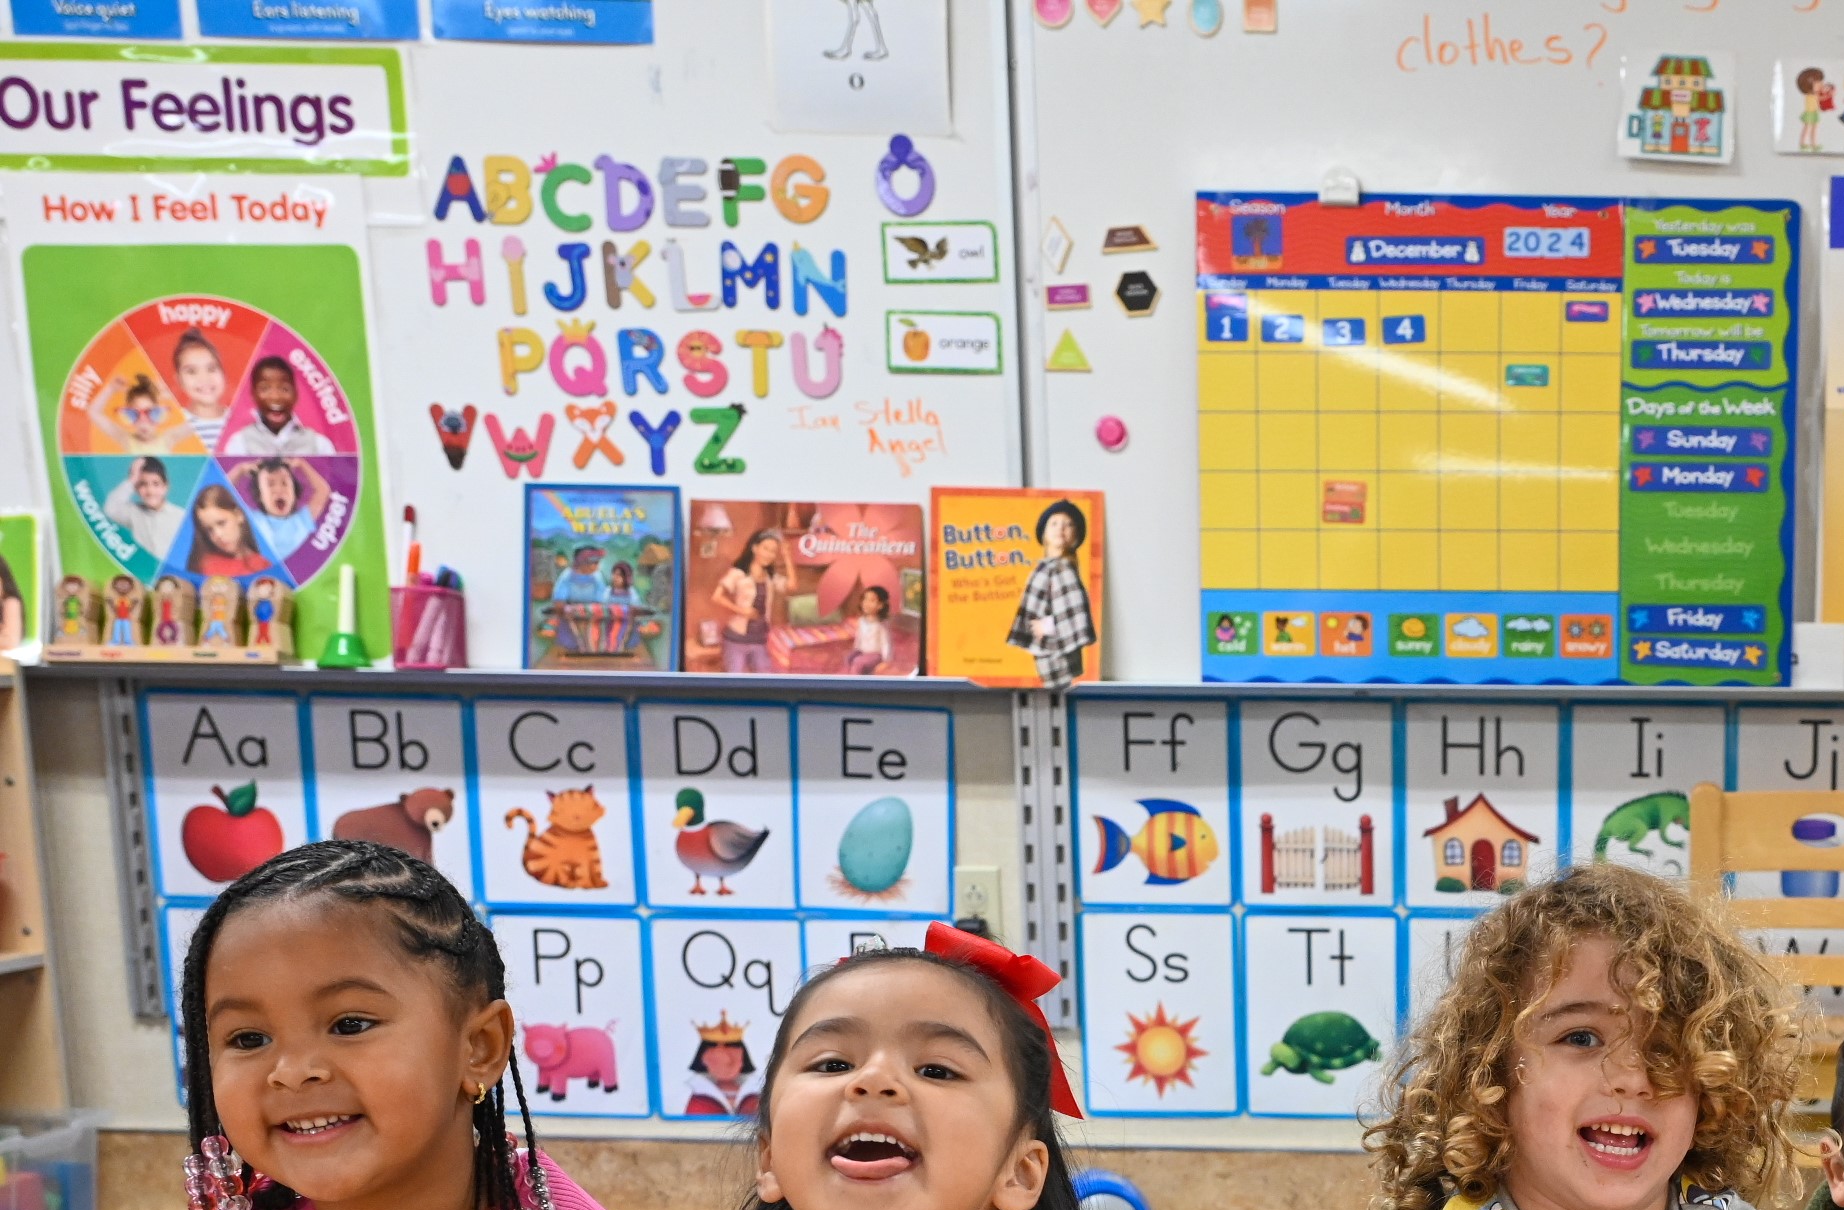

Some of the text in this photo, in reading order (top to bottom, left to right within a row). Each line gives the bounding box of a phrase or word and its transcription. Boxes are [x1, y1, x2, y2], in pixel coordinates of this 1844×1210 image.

[524, 6, 596, 28] watching
[0, 76, 356, 147] Our Feelings
[42, 194, 329, 228] How I Feel Today
[1229, 198, 1287, 215] Season
[1384, 200, 1436, 217] Month
[1542, 202, 1578, 219] Year
[1653, 218, 1757, 236] Yesterday was
[957, 245, 985, 261] owl
[1368, 239, 1463, 259] December
[1507, 230, 1585, 253] 2024
[1666, 237, 1741, 262] Tuesday
[1265, 276, 1309, 290] Monday
[1327, 276, 1371, 290] Tuesday
[1445, 277, 1497, 291] Thursday
[1513, 277, 1550, 292] Friday
[1565, 278, 1619, 293] Saturday
[1675, 270, 1719, 288] Today
[157, 302, 233, 330] happy
[1654, 291, 1754, 315] Wednesday
[1220, 316, 1414, 343] 1 2 3 4
[1638, 323, 1764, 338] Tomorrow will be
[938, 336, 990, 353] orange
[1656, 340, 1745, 367] Thursday
[70, 364, 104, 411] silly
[287, 347, 349, 425] excited
[1626, 396, 1777, 419] Days of the Week
[1666, 429, 1738, 452] Sunday
[1661, 465, 1736, 489] Monday
[73, 478, 137, 563] worried
[310, 489, 350, 552] upset
[1662, 500, 1740, 523] Tuesday
[848, 520, 879, 540] The
[1644, 536, 1756, 558] Wednesday
[1654, 571, 1746, 596] Thursday
[1666, 607, 1725, 632] Friday
[1654, 640, 1742, 666] Saturday
[182, 706, 269, 768] Aa
[349, 709, 430, 771] Bb
[507, 710, 596, 773] Cc
[673, 714, 759, 778] Dd
[841, 717, 908, 781] Ee
[1122, 711, 1195, 773] Ff
[1441, 715, 1525, 777] Hh
[1629, 716, 1665, 780] Ii
[1267, 711, 1364, 802] Gg
[1125, 924, 1190, 984] Ss
[1287, 928, 1355, 987] Tt
[531, 927, 605, 1015] Pp
[681, 928, 785, 1017] Qq
